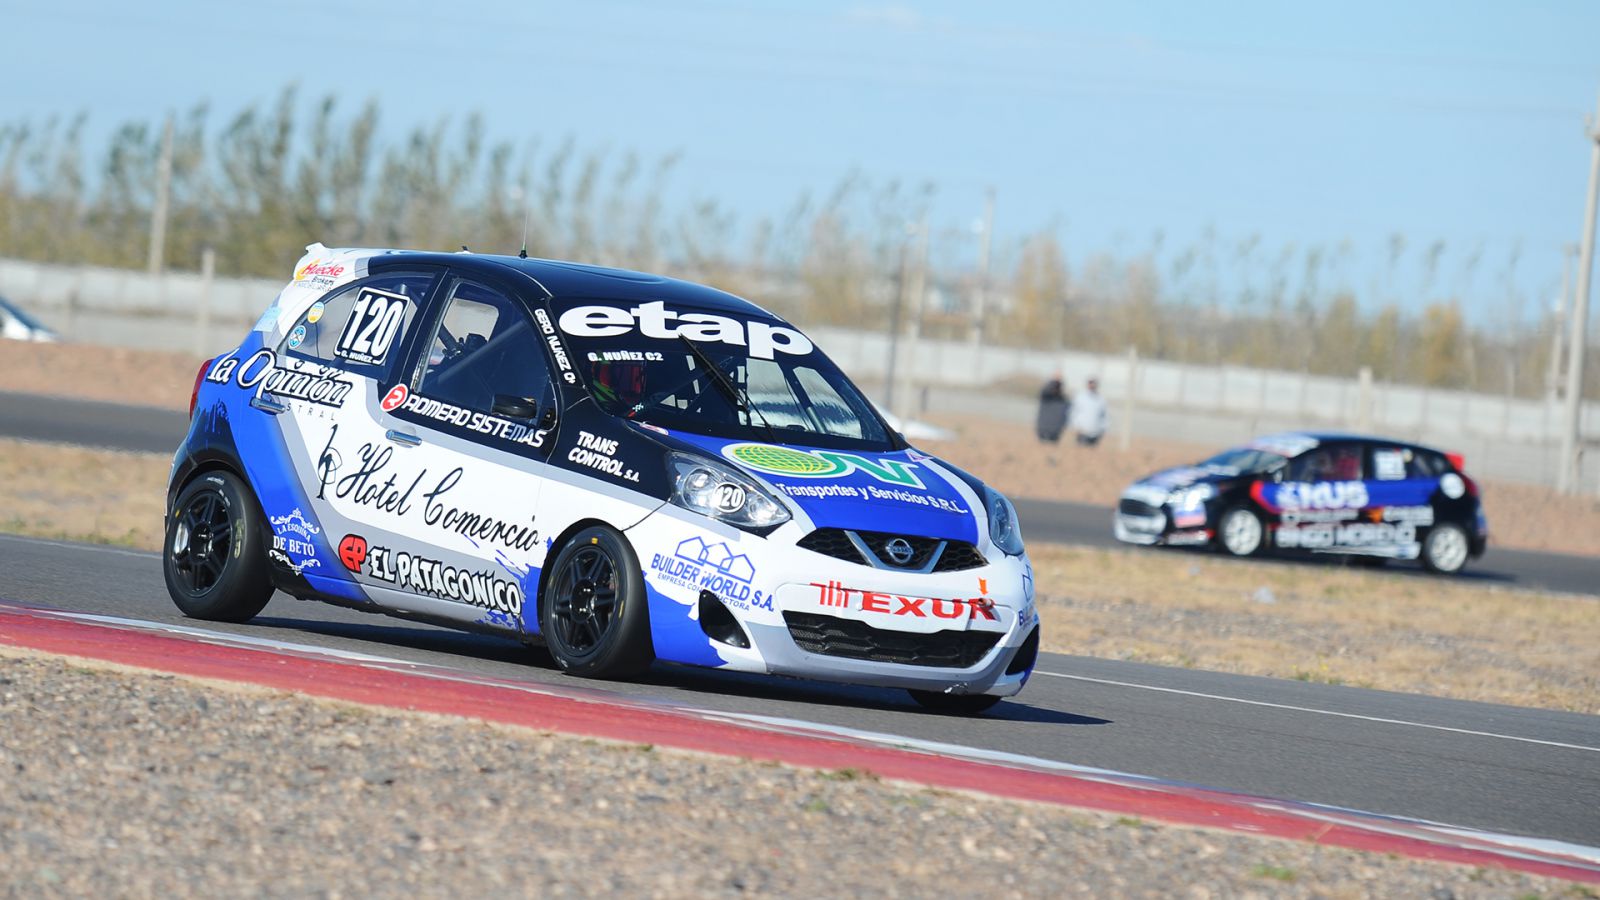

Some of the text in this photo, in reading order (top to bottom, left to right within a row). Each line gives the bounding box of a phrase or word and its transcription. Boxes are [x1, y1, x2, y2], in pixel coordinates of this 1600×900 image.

[342, 294, 404, 357] 120
[534, 308, 555, 334] GERO
[559, 300, 813, 359] etap
[587, 352, 601, 362] G.
[604, 350, 644, 361] NUÑEZ
[401, 394, 547, 448] ROMERO SISTEMAS
[577, 430, 619, 456] TRANS
[568, 447, 640, 482] CONTROL S.A.
[336, 443, 427, 515] Hotel
[423, 467, 540, 552] Comercio
[713, 486, 742, 507] 120
[777, 483, 858, 499] Transportes
[858, 487, 868, 500] y
[868, 486, 930, 505] Servicios
[277, 525, 287, 535] LA
[273, 535, 315, 557] DE BETO
[367, 546, 397, 584] EL
[651, 553, 775, 612] BUILDER WORLD S.A.
[657, 573, 686, 588] EMPRESA
